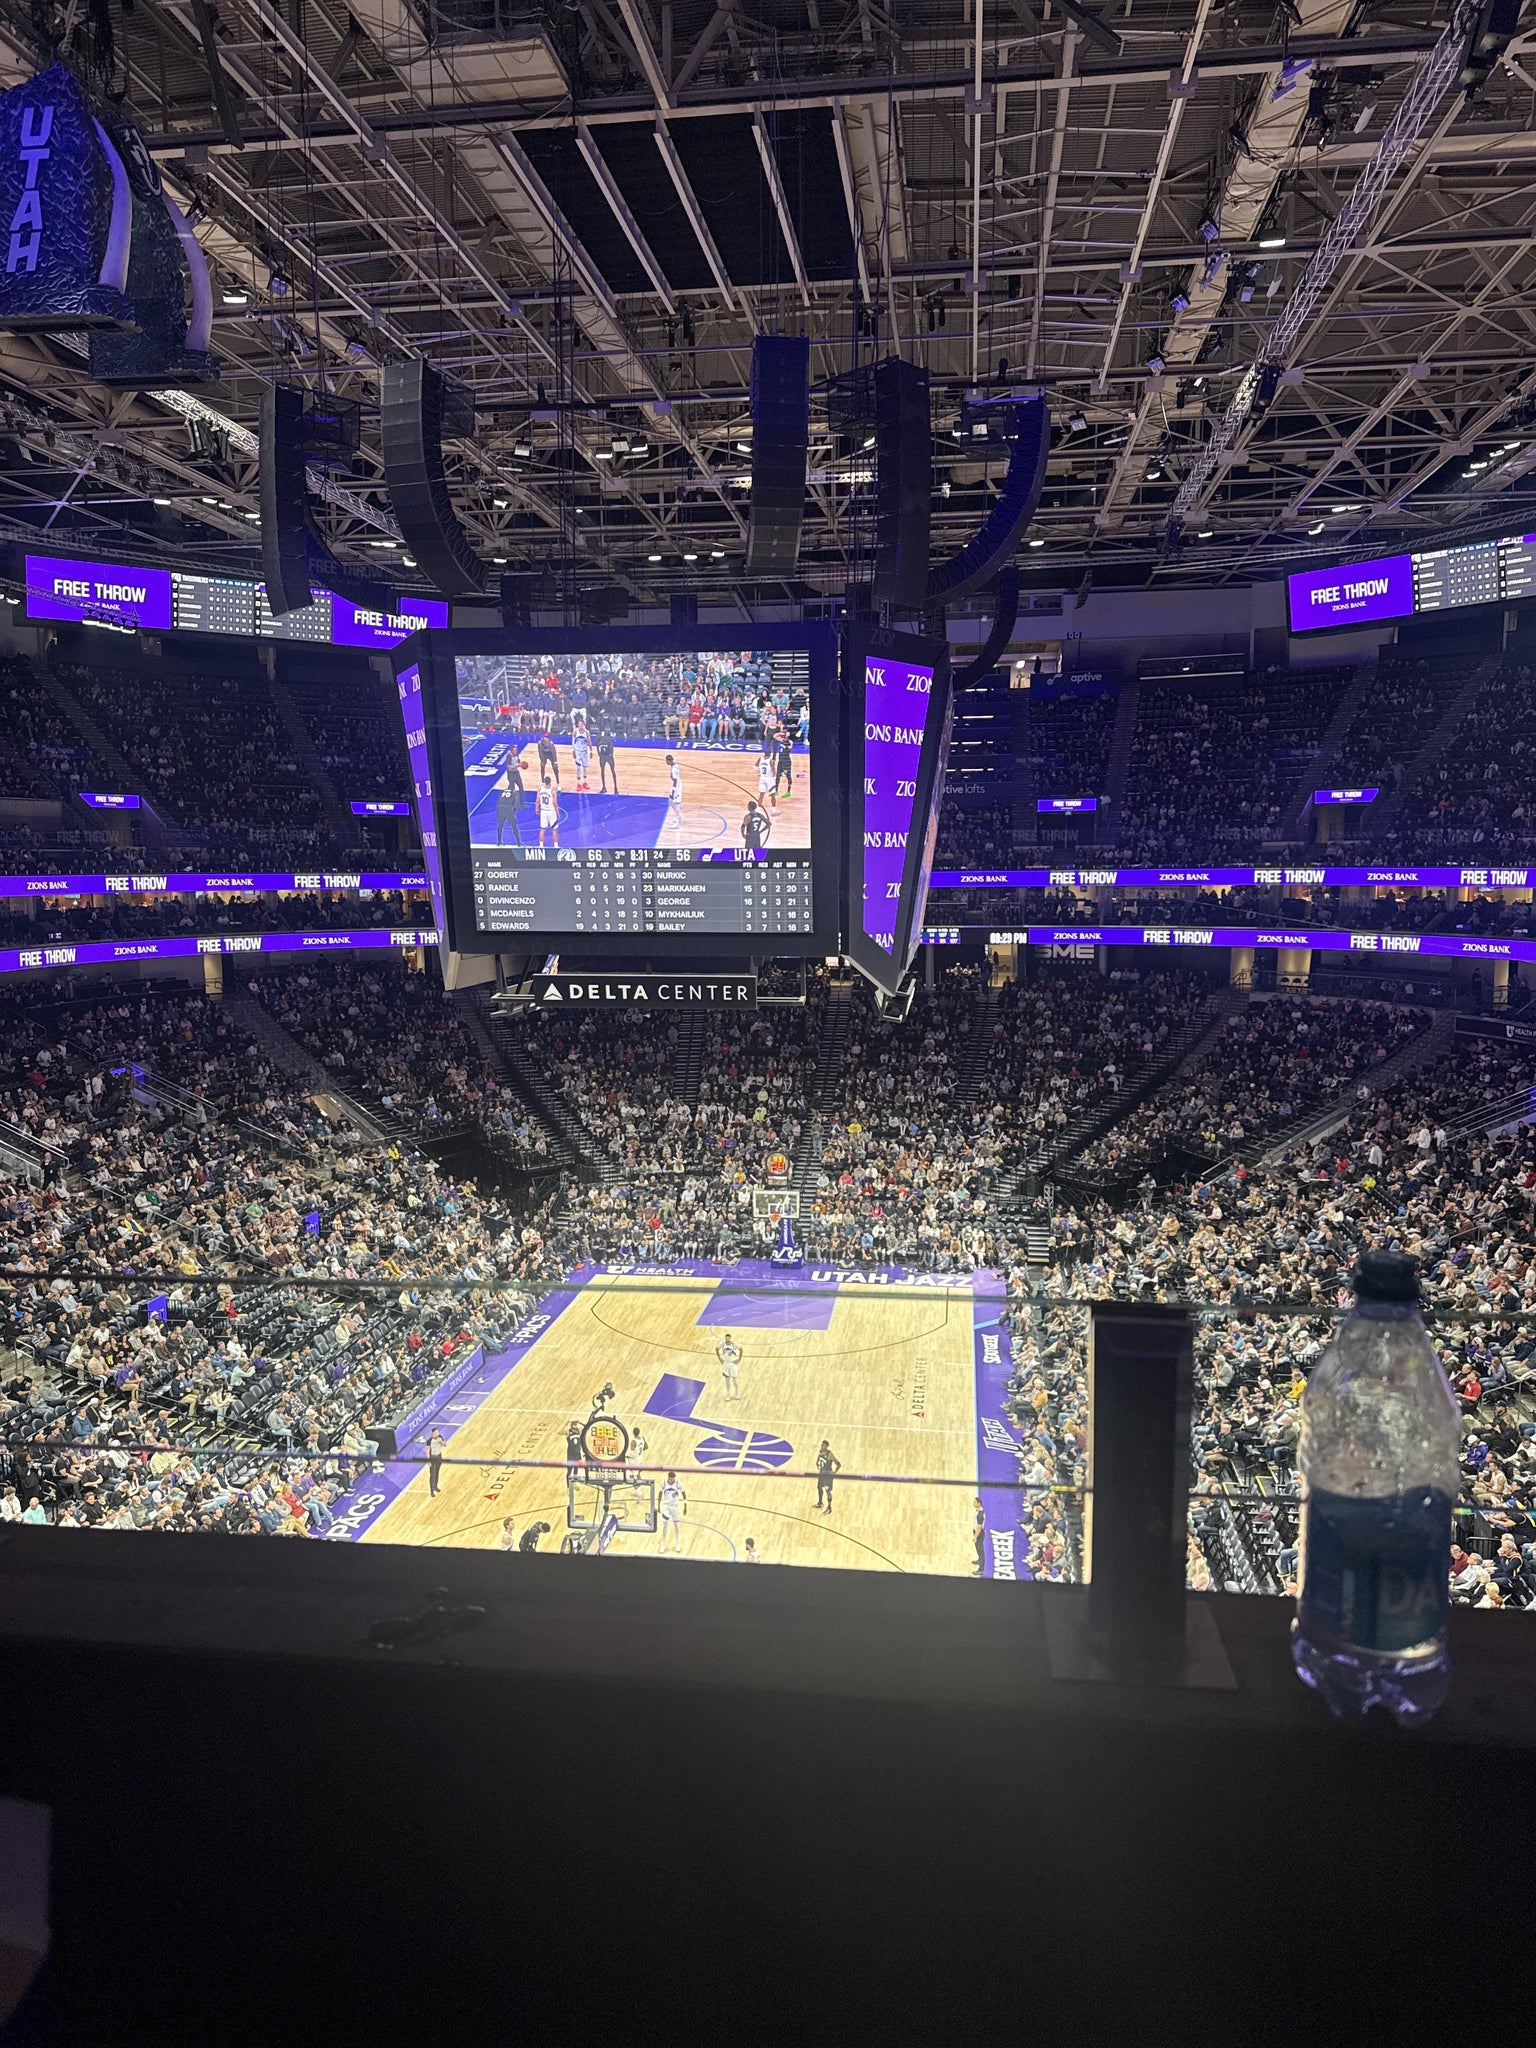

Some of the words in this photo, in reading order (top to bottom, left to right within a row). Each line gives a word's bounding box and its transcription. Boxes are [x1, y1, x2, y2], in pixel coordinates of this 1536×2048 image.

[6, 106, 54, 273] UTAH
[54, 579, 90, 597] FREE
[94, 583, 146, 602] THROW
[1311, 586, 1340, 605] FREE
[1343, 578, 1388, 599] THROW
[102, 603, 120, 611] BANK
[354, 609, 383, 626] FREE
[386, 614, 428, 630] THROW
[1070, 672, 1102, 685] aptive
[864, 722, 892, 742] ONS
[894, 726, 924, 746] BANK
[692, 742, 764, 751] PACS
[479, 744, 508, 765] HEALTH
[943, 784, 964, 794] tive
[965, 784, 986, 794] lofts
[107, 796, 124, 804] THROW
[542, 795, 550, 805] 10
[753, 823, 758, 832] 5
[525, 849, 546, 860] MIN
[588, 850, 602, 861] 66
[630, 850, 648, 861] 8:31
[677, 850, 690, 861] 56
[734, 849, 756, 860] UTA
[106, 877, 129, 890] FREE
[131, 877, 167, 890] THROW
[294, 876, 320, 888] FREE
[323, 875, 360, 888] THROW
[1050, 872, 1075, 884] FREE
[1078, 872, 1117, 884] THROW
[1254, 870, 1282, 883] FREE
[1284, 870, 1325, 883] THROW
[1461, 870, 1488, 884] FREE
[1490, 870, 1527, 885] THROW
[391, 933, 416, 944] FREE
[418, 932, 439, 944] THR
[1013, 932, 1028, 944] PM
[1144, 930, 1170, 943] FREE
[1173, 930, 1213, 944] THROW
[1351, 935, 1378, 949] FREE
[1381, 936, 1420, 951] THROW
[114, 947, 136, 955] ZIONS
[138, 945, 158, 953] BANK
[197, 939, 221, 952] FREE
[224, 938, 261, 952] THROW
[1035, 944, 1094, 958] SME
[1462, 943, 1487, 952] ZIONS
[1489, 945, 1510, 953] BANK
[20, 951, 42, 966] FREE
[44, 948, 76, 964] THROW
[570, 984, 648, 1000] DELTA
[658, 984, 748, 1001] CENTER
[810, 1270, 888, 1285] UTAH
[894, 1272, 974, 1288] JAZZ
[515, 1314, 552, 1338] PACS
[914, 1358, 928, 1380] CENTER
[912, 1384, 927, 1410] DELTA
[408, 1414, 424, 1434] ZIONS
[517, 1423, 551, 1454] CENTER
[326, 1494, 386, 1538] PACS
[989, 1529, 1016, 1580] EATGEEK
